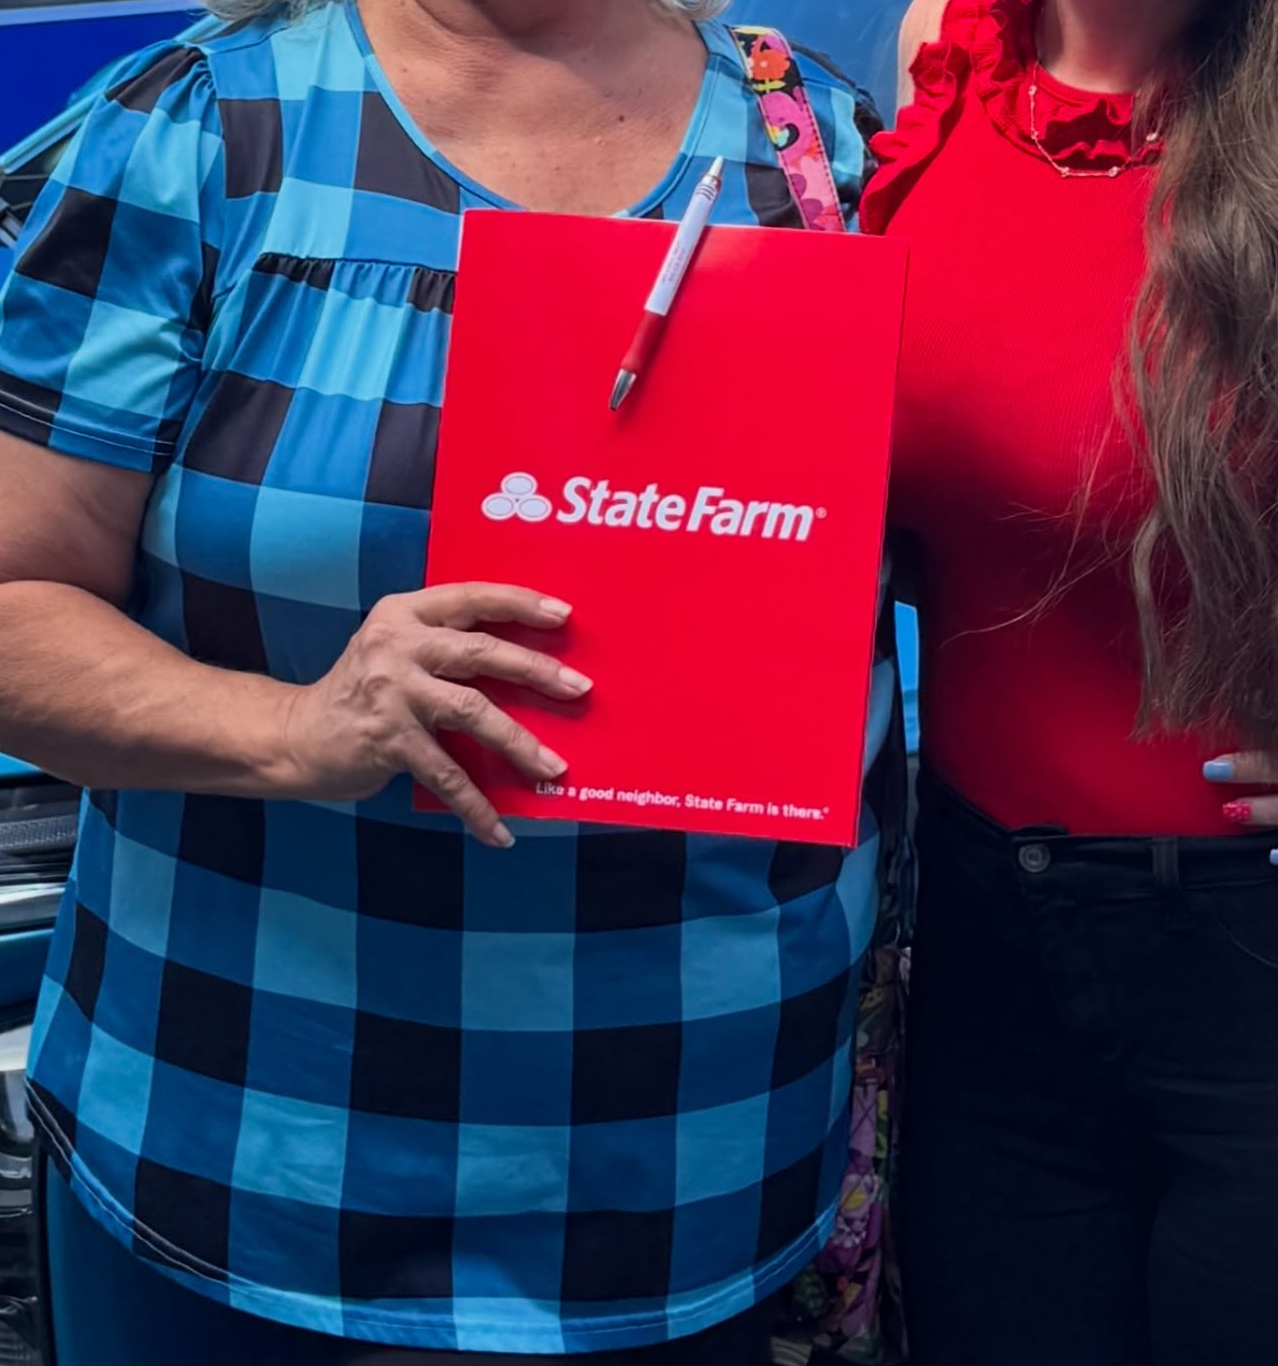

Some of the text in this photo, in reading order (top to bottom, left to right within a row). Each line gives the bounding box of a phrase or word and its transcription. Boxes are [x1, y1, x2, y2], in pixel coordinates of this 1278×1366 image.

[567, 786, 576, 797] a
[579, 787, 614, 801] good
[616, 789, 681, 808] neighbor,
[684, 793, 723, 810] State
[726, 797, 764, 815] Farm
[766, 802, 779, 816] is
